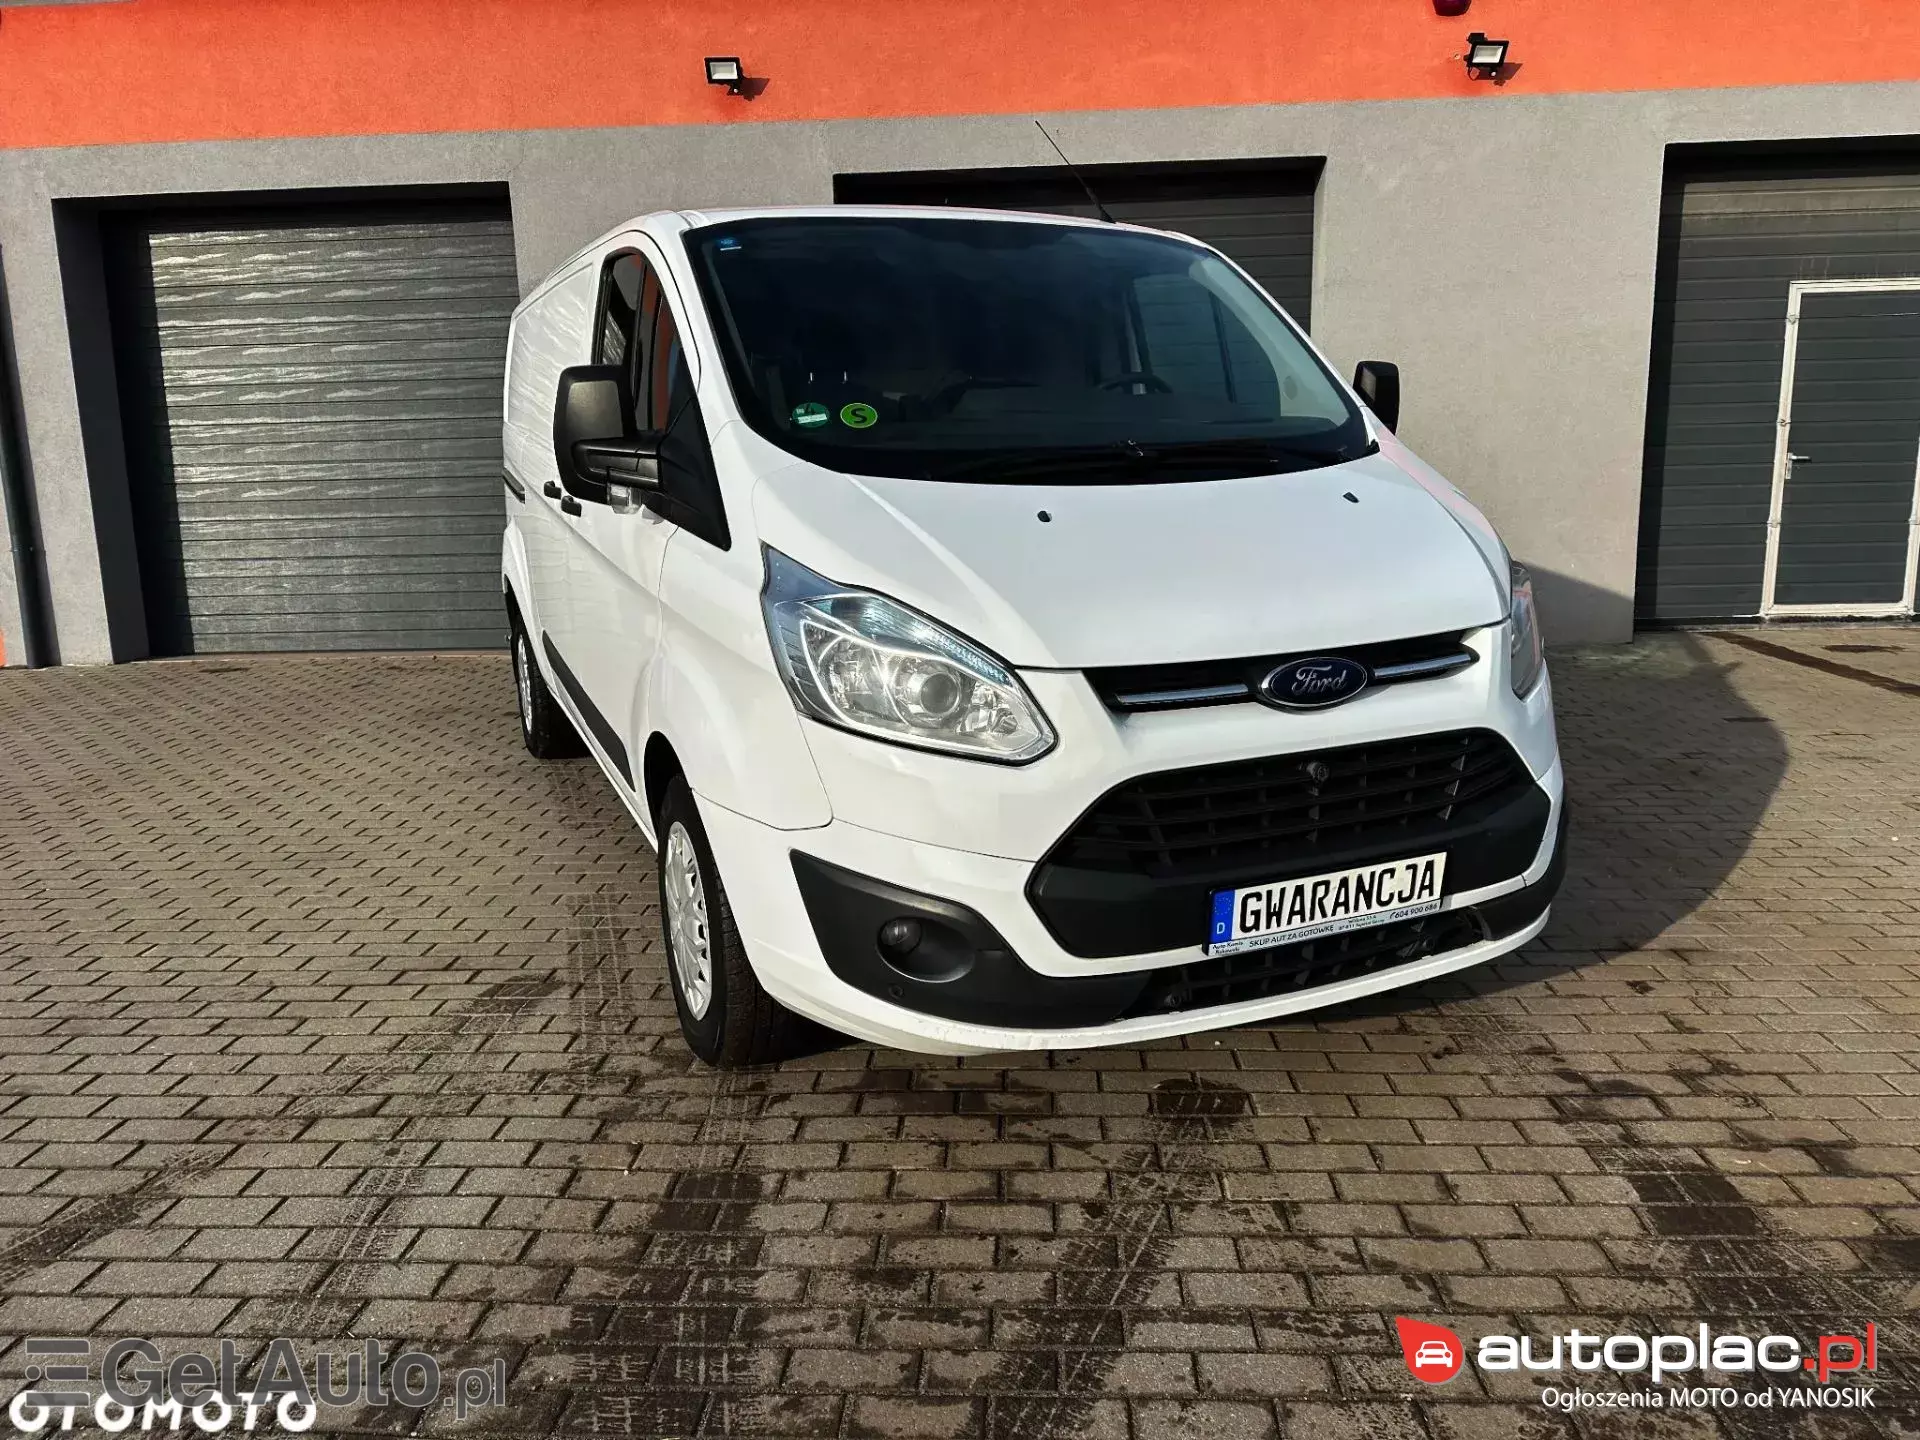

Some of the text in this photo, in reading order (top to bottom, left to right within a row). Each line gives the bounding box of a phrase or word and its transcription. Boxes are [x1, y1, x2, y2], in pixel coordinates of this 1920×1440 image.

[850, 407, 868, 424] S
[1291, 664, 1347, 696] Ford
[1238, 859, 1436, 934] GWARANCJA
[1394, 909, 1409, 919] 604
[1410, 906, 1424, 916] 900
[1216, 922, 1226, 935] D
[1249, 937, 1270, 948] SKUP
[1270, 934, 1287, 944] AUT
[1287, 932, 1298, 941] ZA
